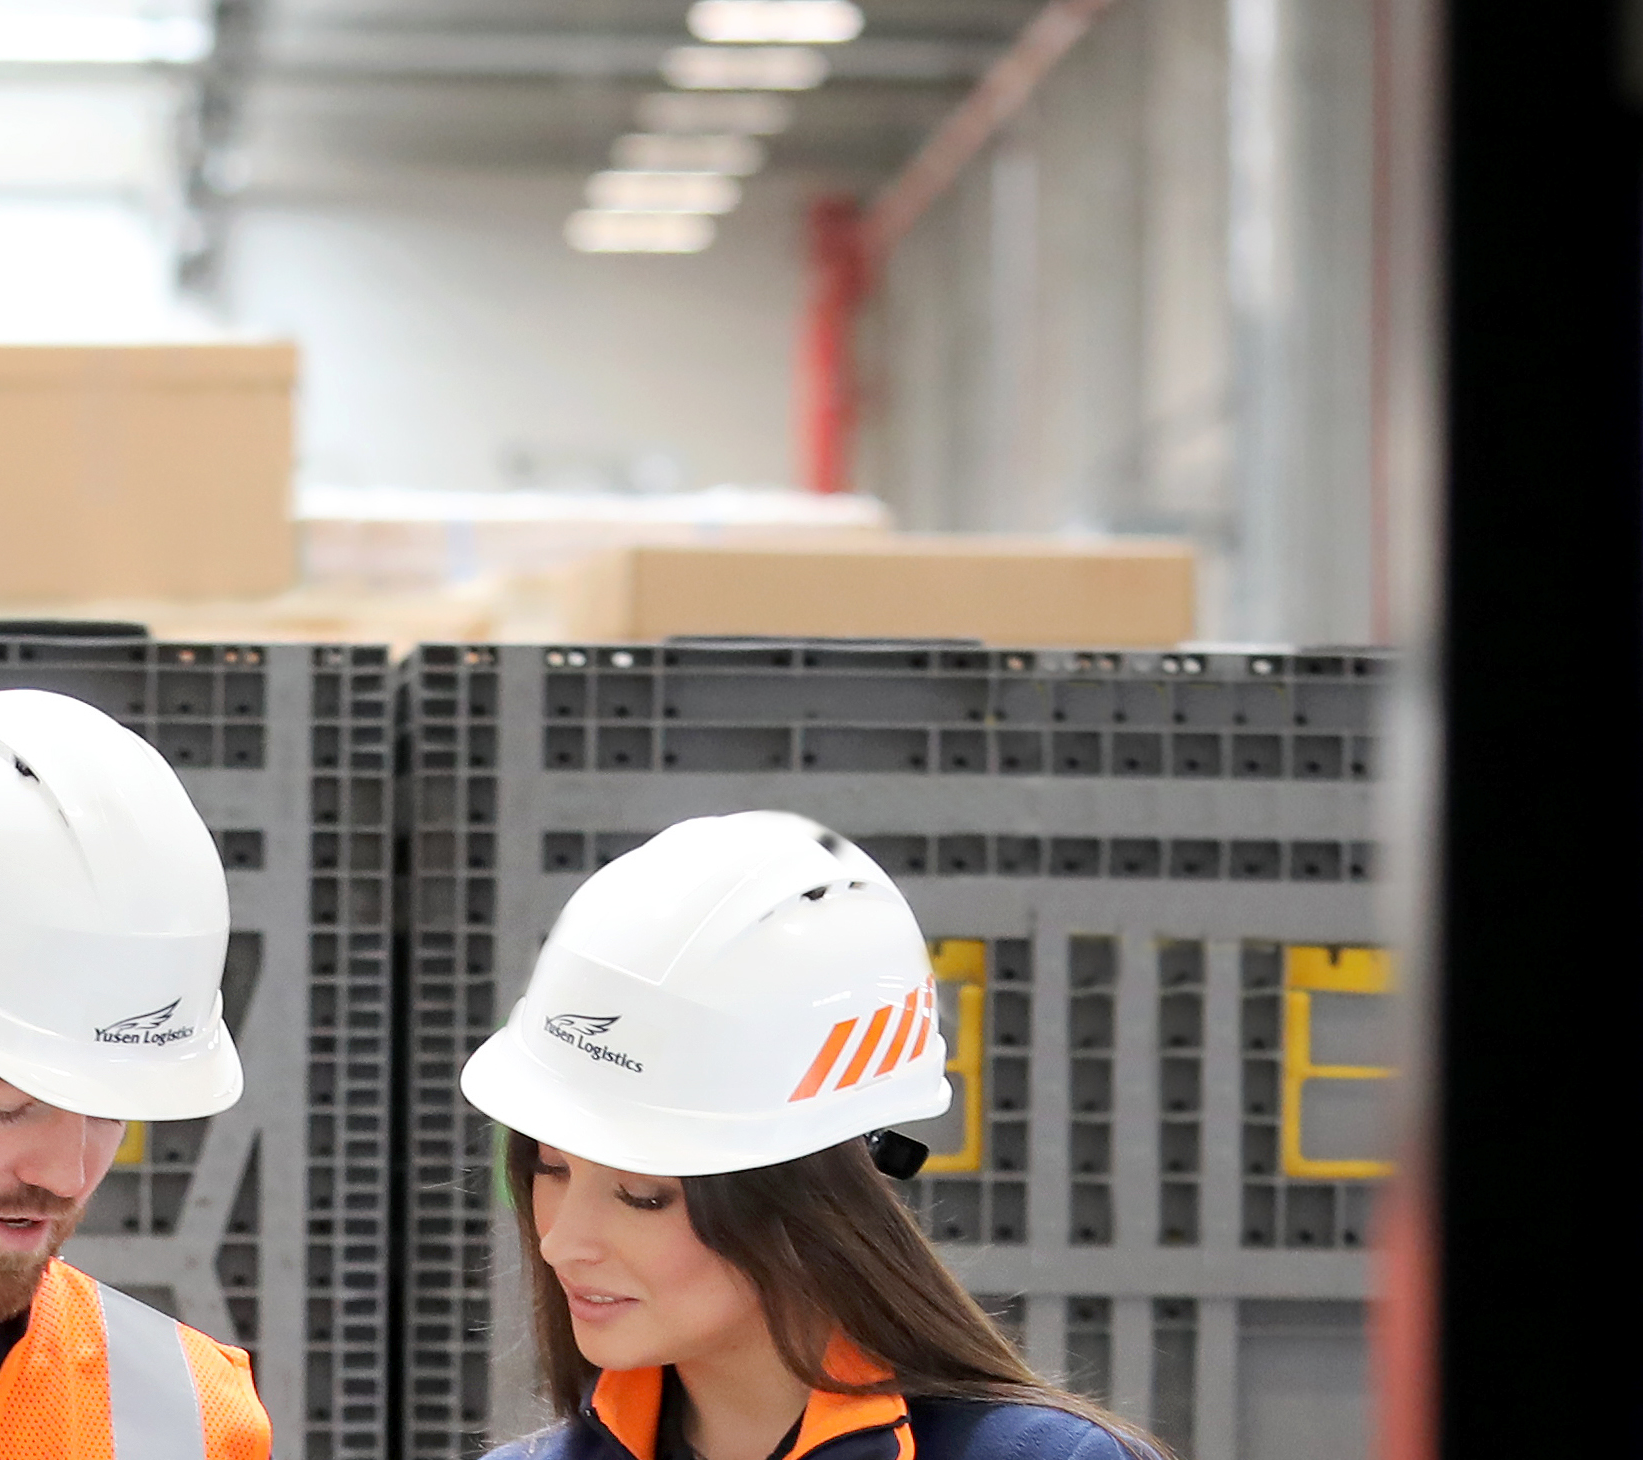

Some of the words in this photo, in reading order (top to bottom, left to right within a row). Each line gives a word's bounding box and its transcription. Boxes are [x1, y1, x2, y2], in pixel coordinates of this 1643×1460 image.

[94, 1027, 140, 1044] Yusen
[544, 1015, 575, 1045] Yusen
[577, 1034, 644, 1073] Logistics
